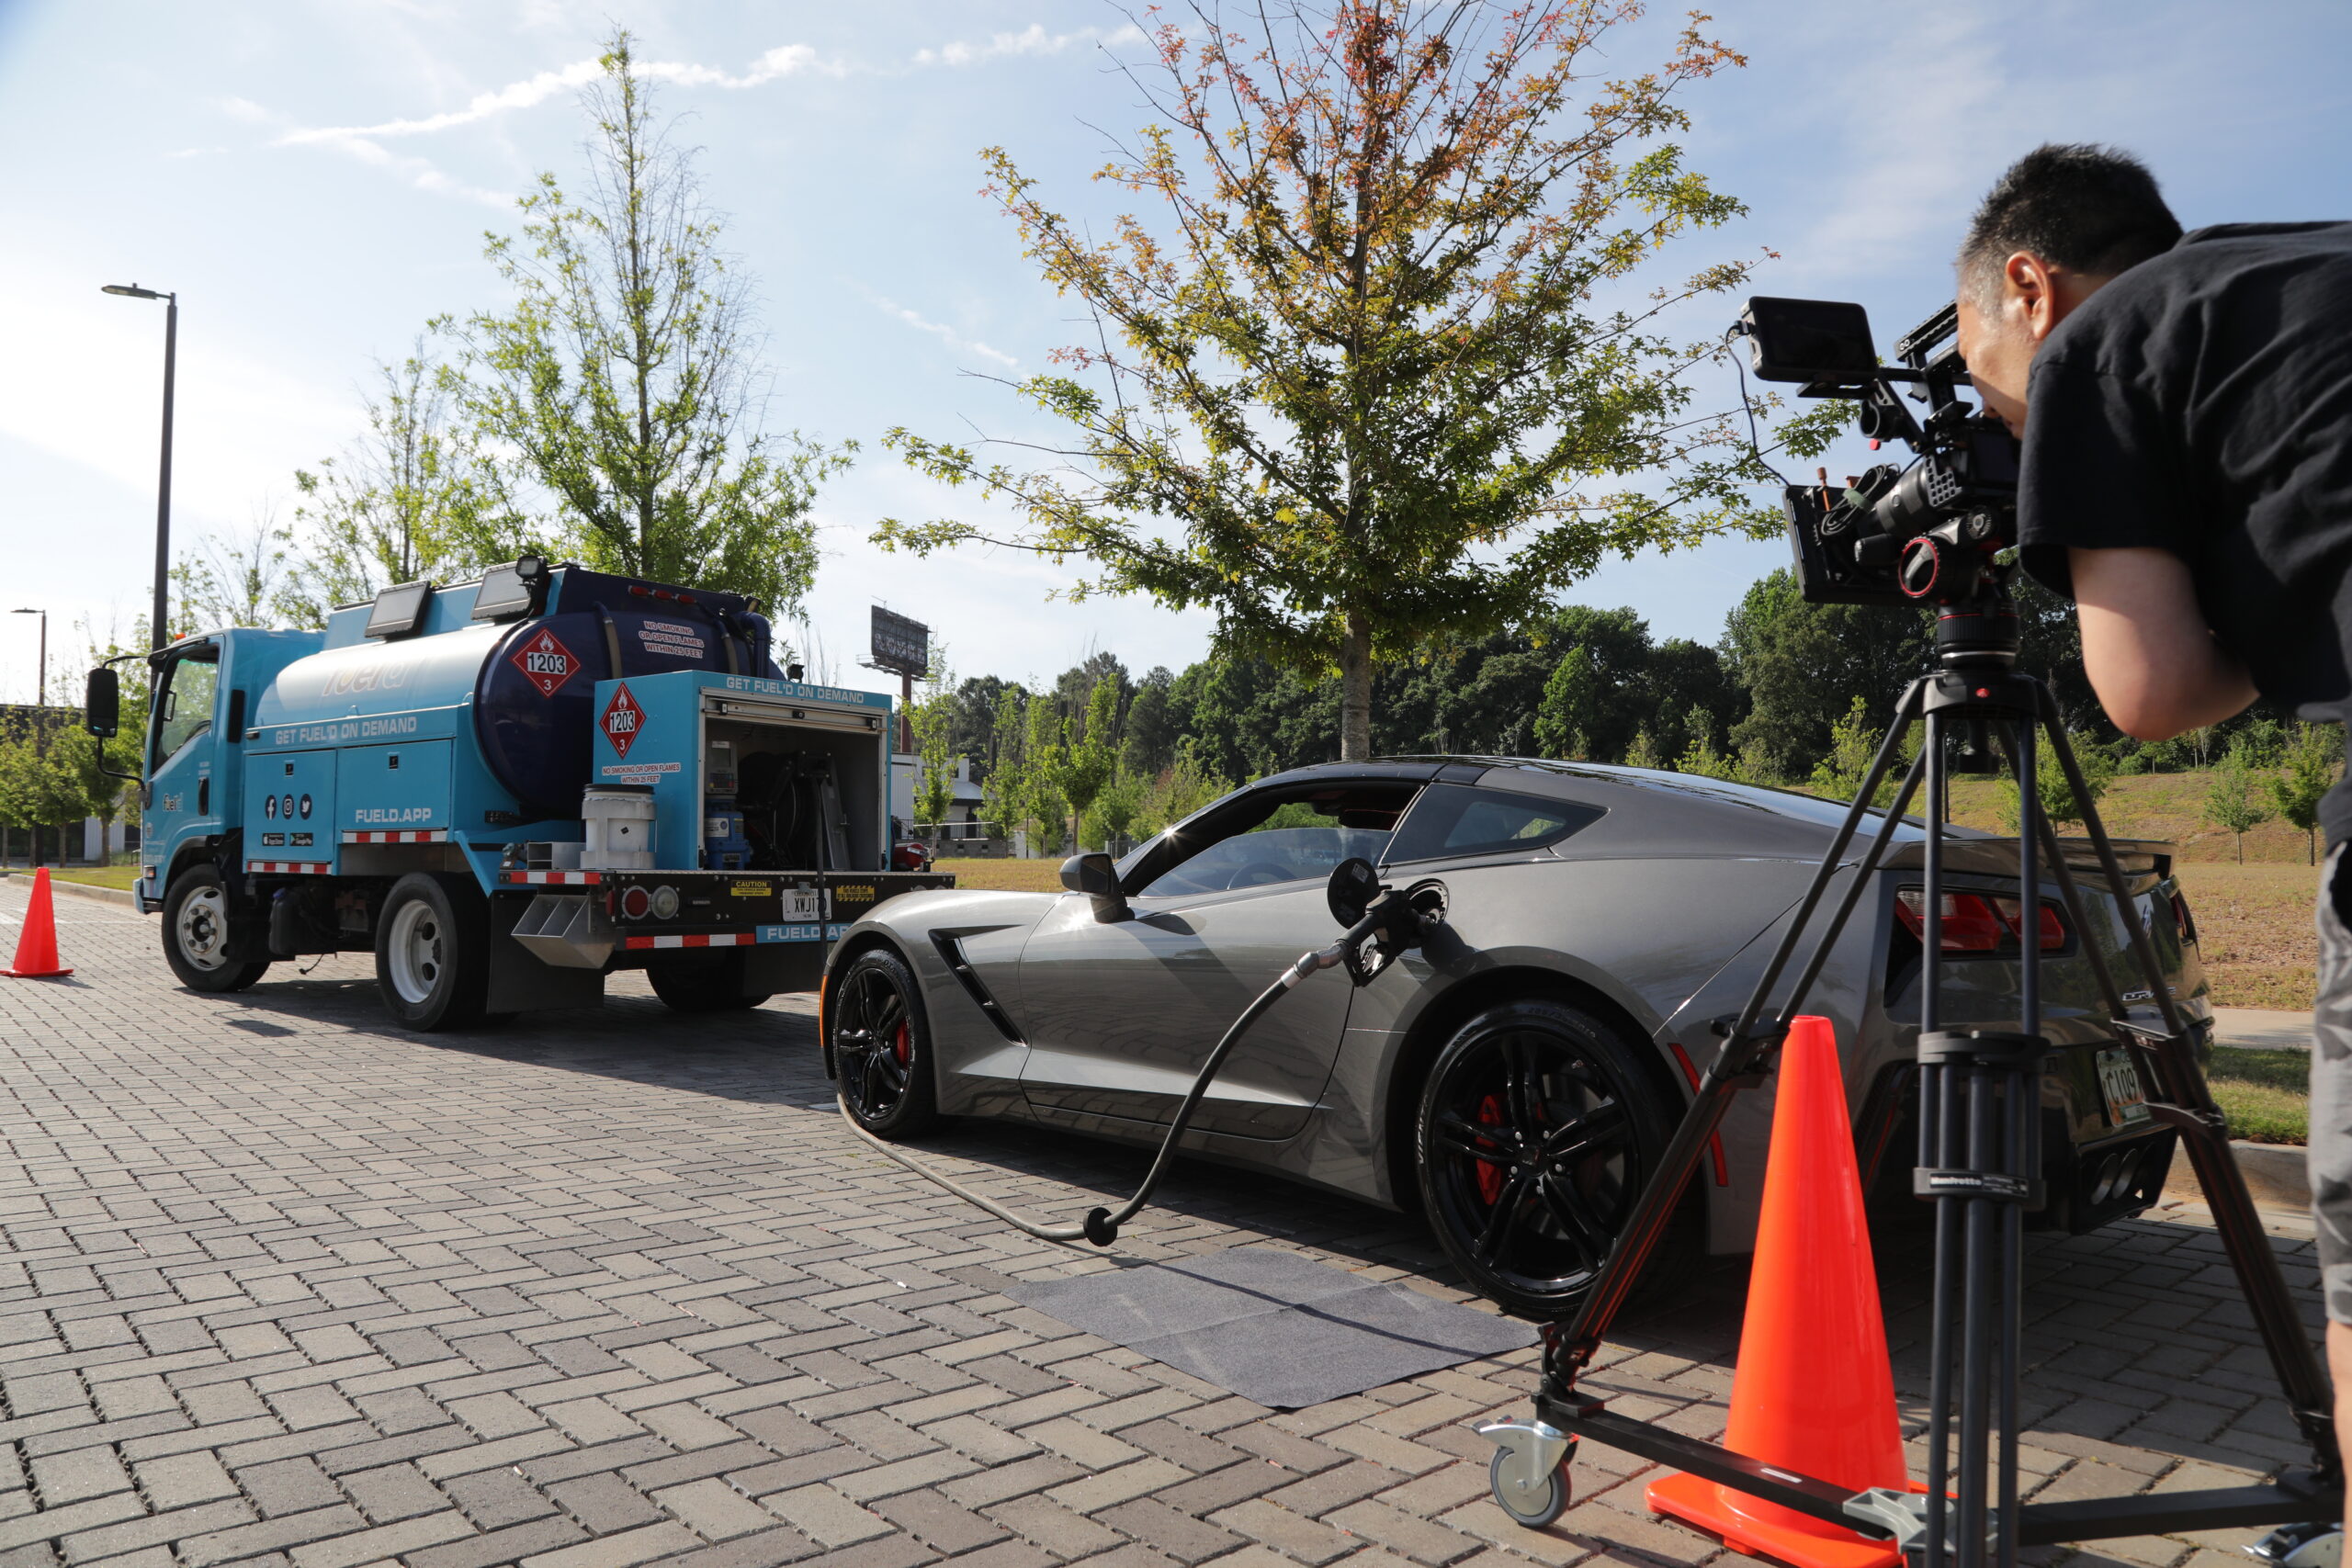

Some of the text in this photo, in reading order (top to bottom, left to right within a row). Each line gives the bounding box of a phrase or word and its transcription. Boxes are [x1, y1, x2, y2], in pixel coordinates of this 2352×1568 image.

[645, 621, 694, 636] NO SMOKING
[640, 631, 704, 648] OR OPEN FLAMES
[645, 643, 703, 659] WITHIN 25 FEET
[528, 653, 566, 673] 1203
[544, 680, 551, 690] 3
[727, 676, 865, 704] GET FUEL'D ON DEMAND
[610, 711, 635, 732] 1203
[276, 716, 417, 745] GET FUEL'D ON DEMAND
[620, 739, 626, 750] 3
[612, 765, 634, 774] SMOKING
[645, 763, 658, 773] OPEN
[622, 775, 639, 784] WITHIN
[356, 808, 432, 823] FUELD.APP
